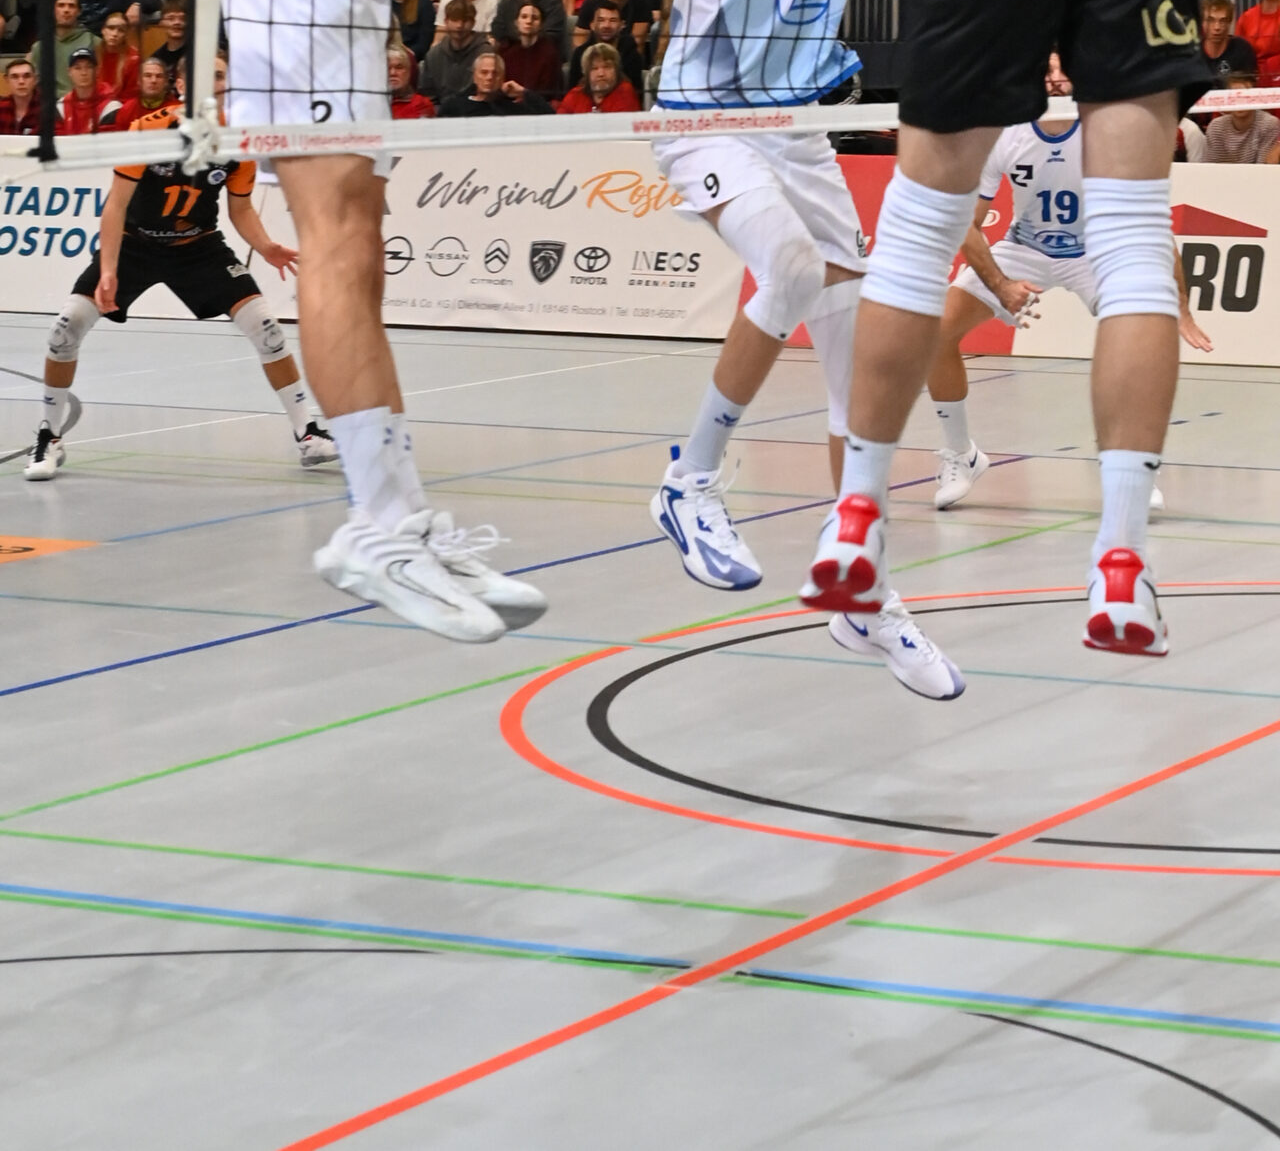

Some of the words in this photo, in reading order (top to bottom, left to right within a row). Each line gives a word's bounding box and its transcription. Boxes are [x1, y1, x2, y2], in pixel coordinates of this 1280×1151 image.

[253, 134, 288, 152] OSPA
[416, 168, 489, 209] Wir
[484, 169, 577, 218] sind
[703, 173, 720, 198] 9
[0, 186, 109, 218] TADT
[1036, 190, 1079, 225] 19
[425, 252, 469, 262] NISSAN
[631, 250, 702, 273] INEOS
[570, 276, 608, 287] TOYOTA
[628, 279, 696, 289] GRENADIER
[571, 305, 607, 316] Rostock
